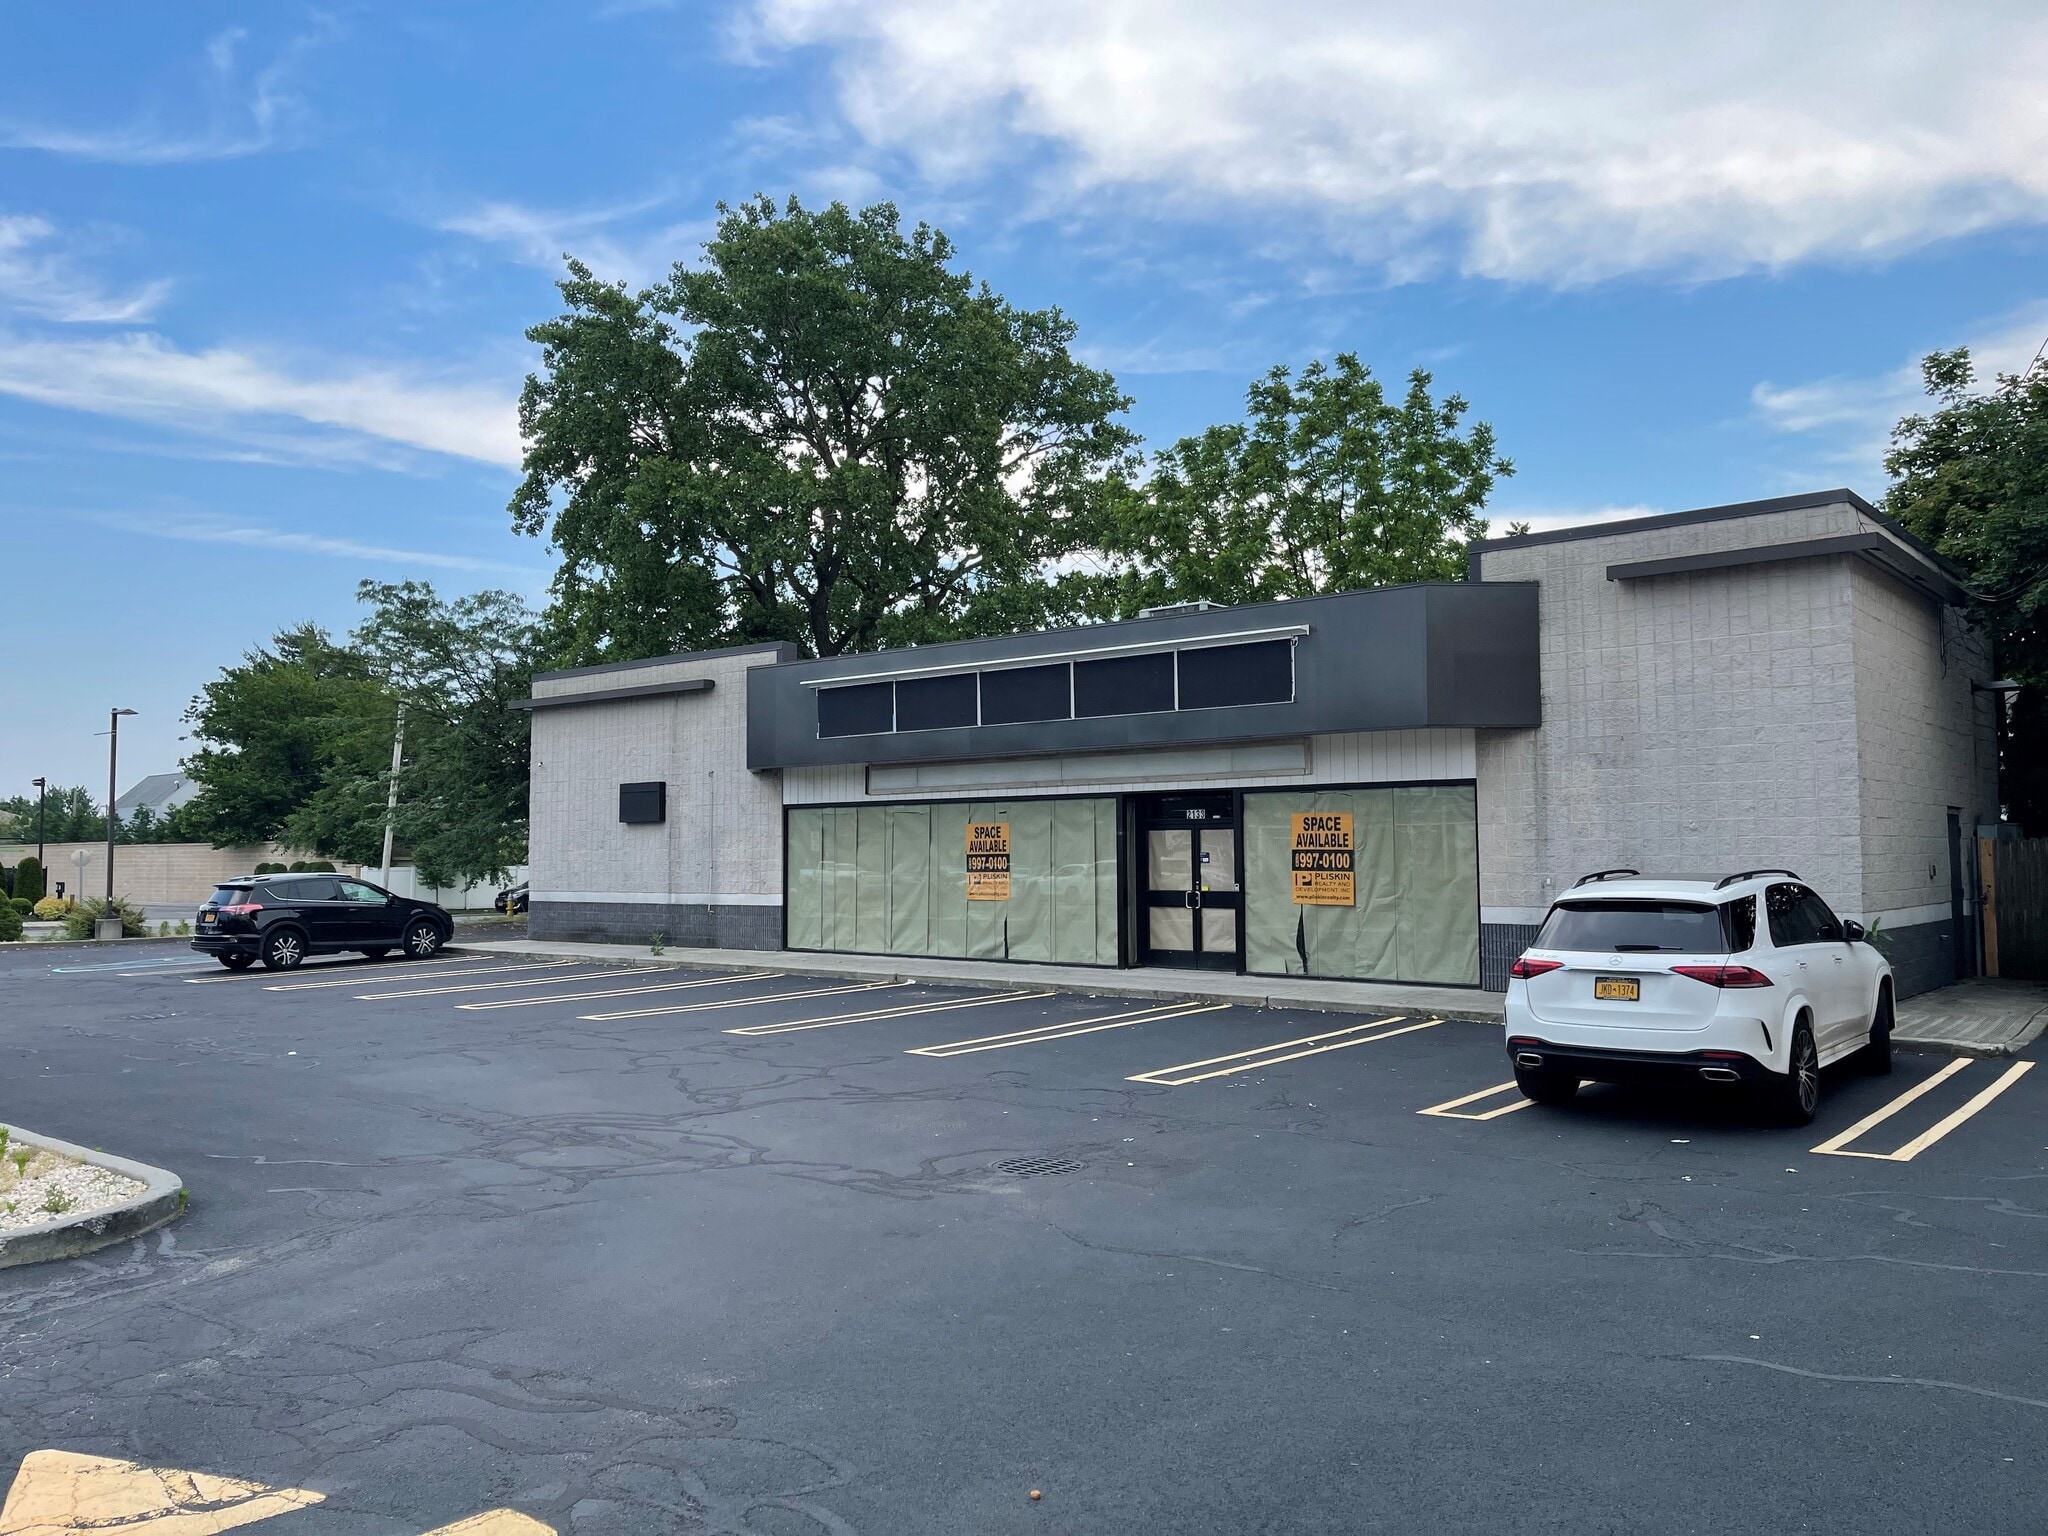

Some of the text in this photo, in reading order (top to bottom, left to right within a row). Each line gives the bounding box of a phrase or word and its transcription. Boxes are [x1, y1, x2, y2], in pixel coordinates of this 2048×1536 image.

[1303, 817, 1341, 831] SPACE
[974, 826, 1002, 839] SPACE
[969, 840, 1007, 852] AVAILABLE
[1296, 833, 1348, 848] AVAILABLE
[972, 857, 1008, 870] 997-0100
[1300, 853, 1350, 868] 997-0100
